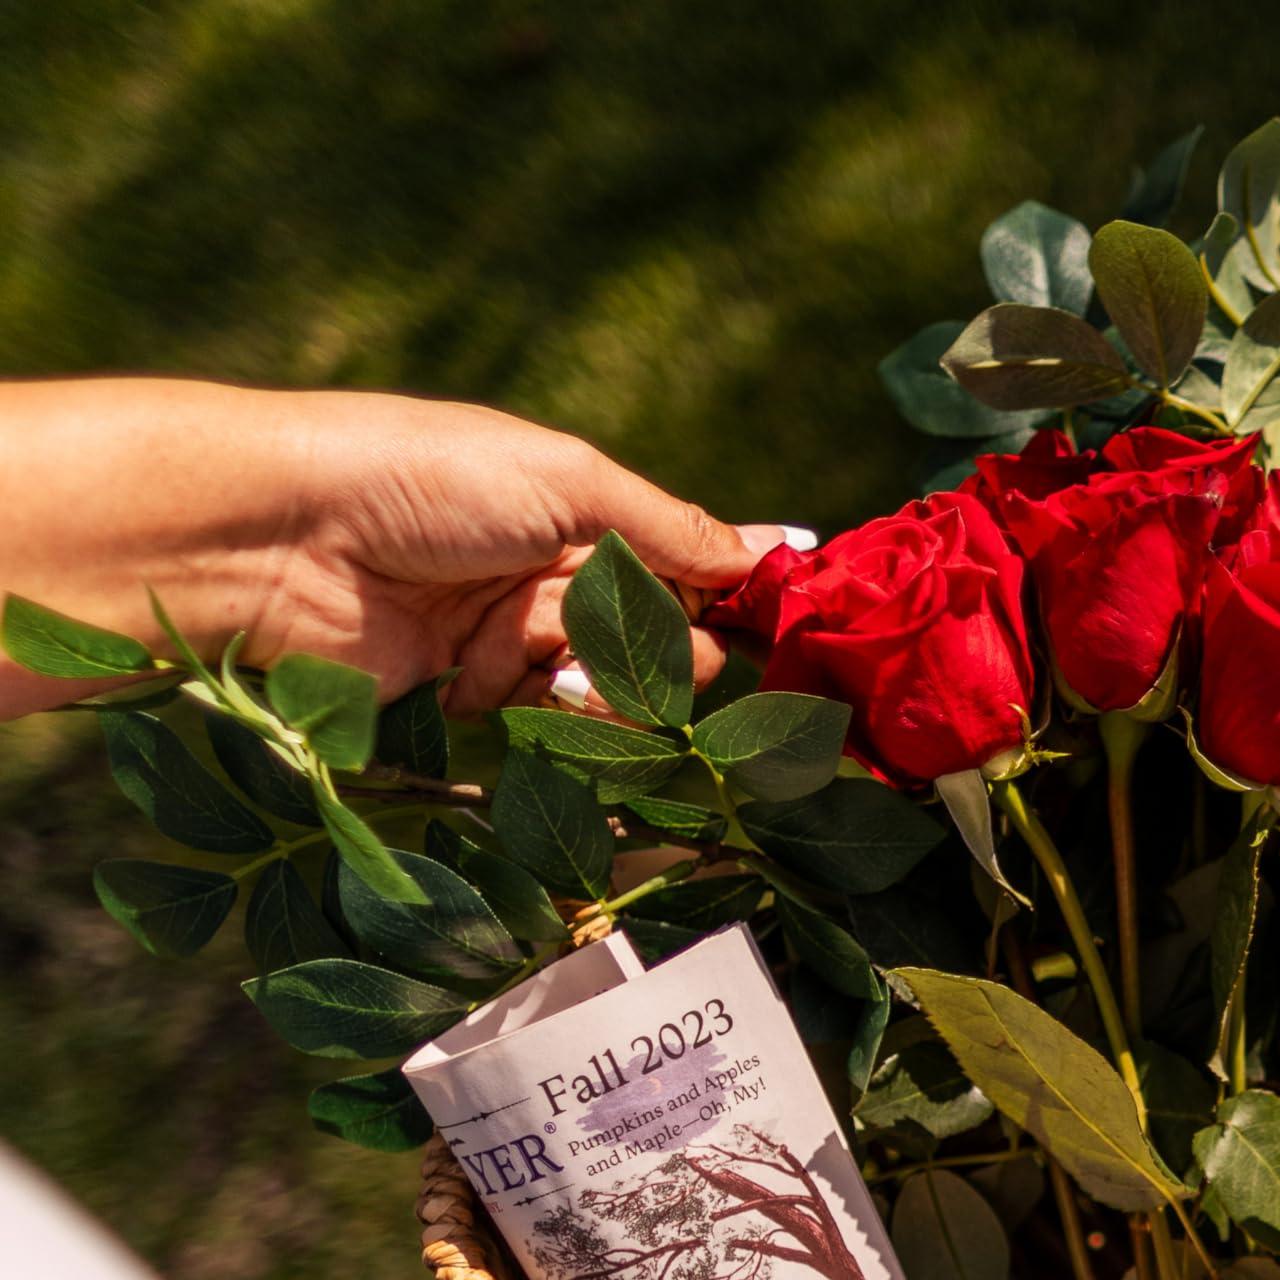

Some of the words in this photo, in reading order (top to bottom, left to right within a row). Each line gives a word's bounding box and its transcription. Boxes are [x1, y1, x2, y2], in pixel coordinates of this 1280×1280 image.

[537, 1048, 630, 1117] Fall
[630, 998, 734, 1075] 2023
[567, 1103, 664, 1156] Pumpkins
[668, 1084, 701, 1112] and
[704, 1054, 761, 1093] Apples
[461, 1134, 564, 1196] YER
[586, 1147, 622, 1177] and
[733, 1077, 768, 1106] My!
